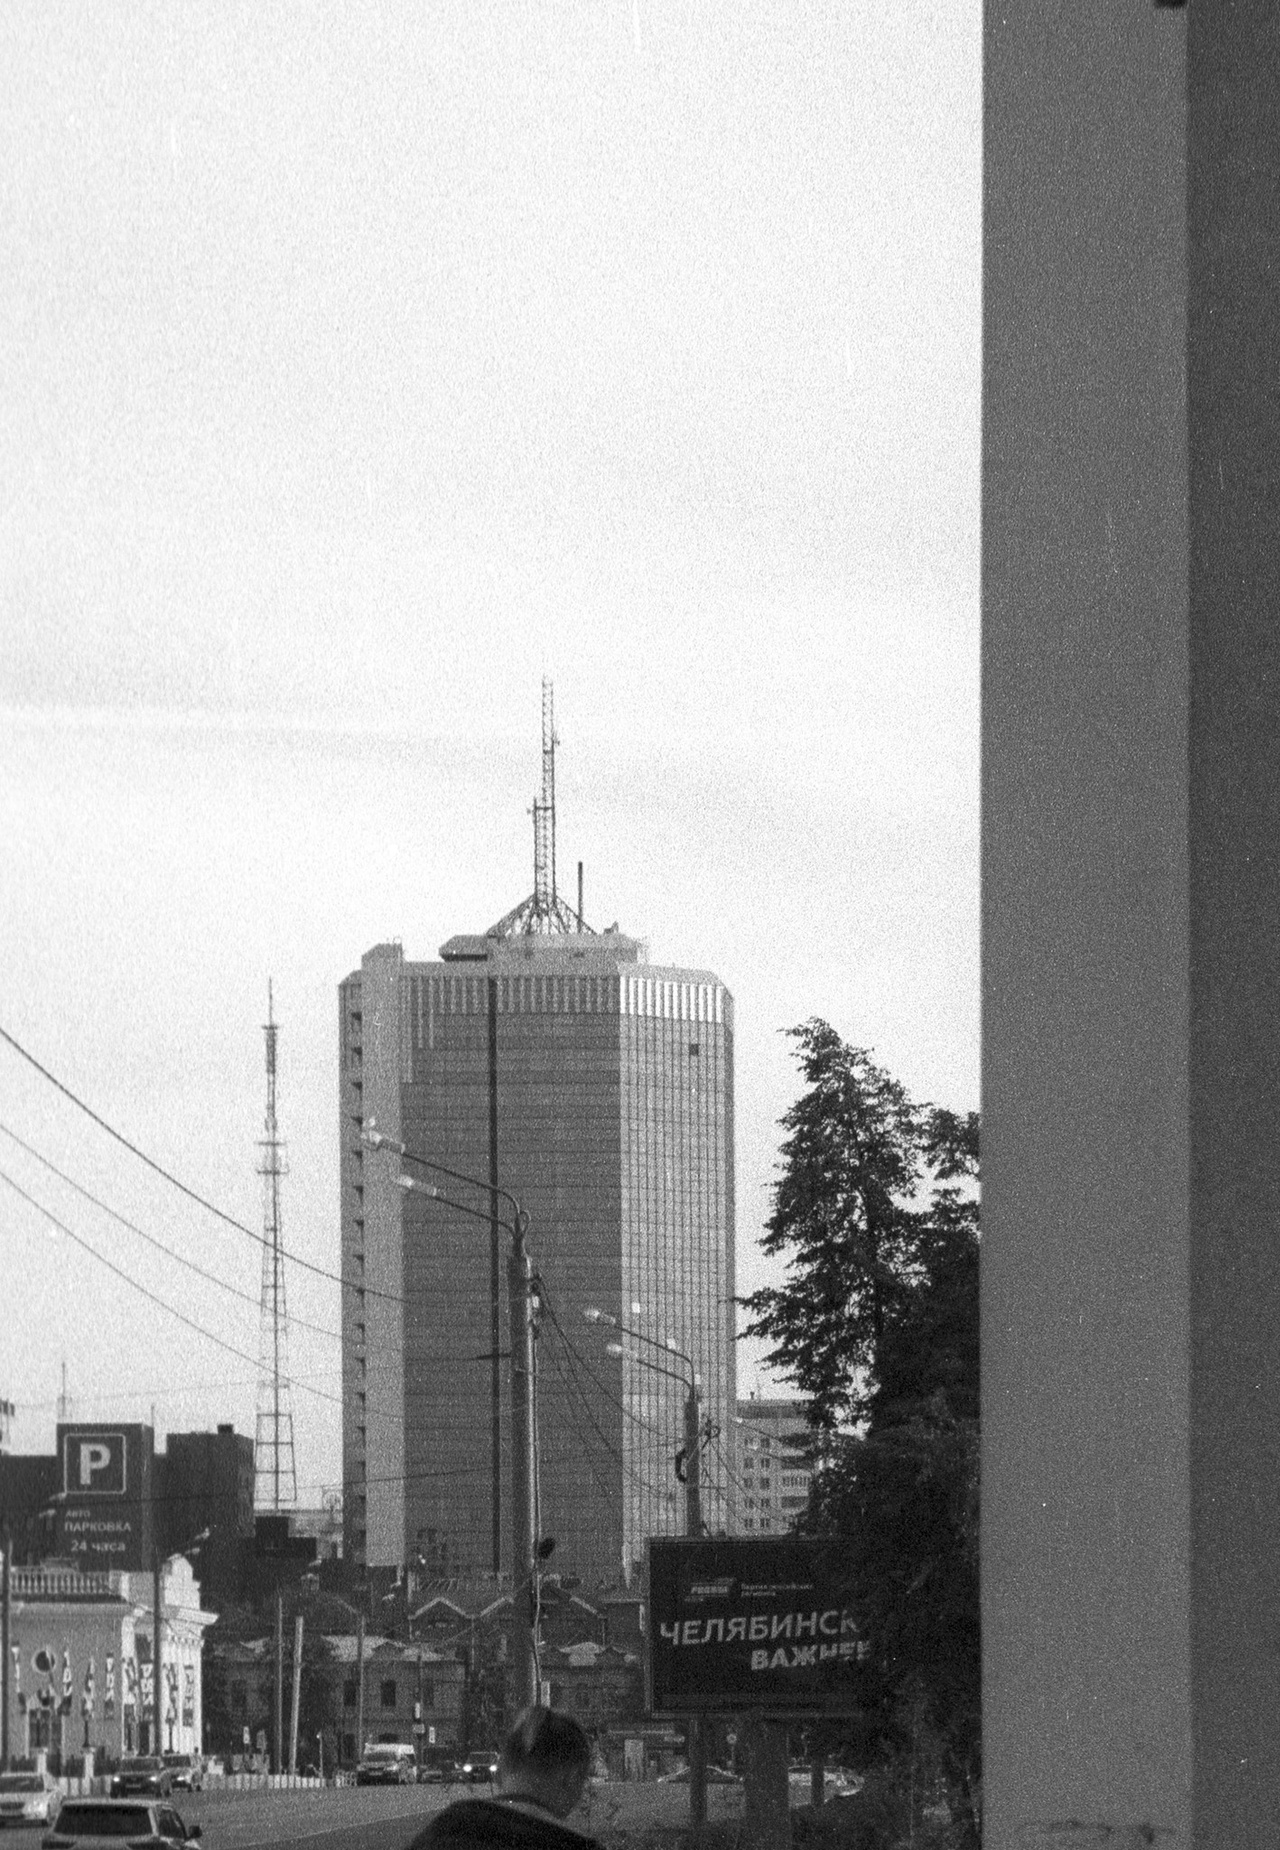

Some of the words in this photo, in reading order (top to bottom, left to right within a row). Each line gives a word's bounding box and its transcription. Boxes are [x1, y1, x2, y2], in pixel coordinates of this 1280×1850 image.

[80, 1443, 111, 1485] P
[64, 1521, 132, 1532] ПАРКОВКА
[71, 1540, 87, 1552] 24
[660, 1609, 860, 1645] ЧЕЛЯБИНСК
